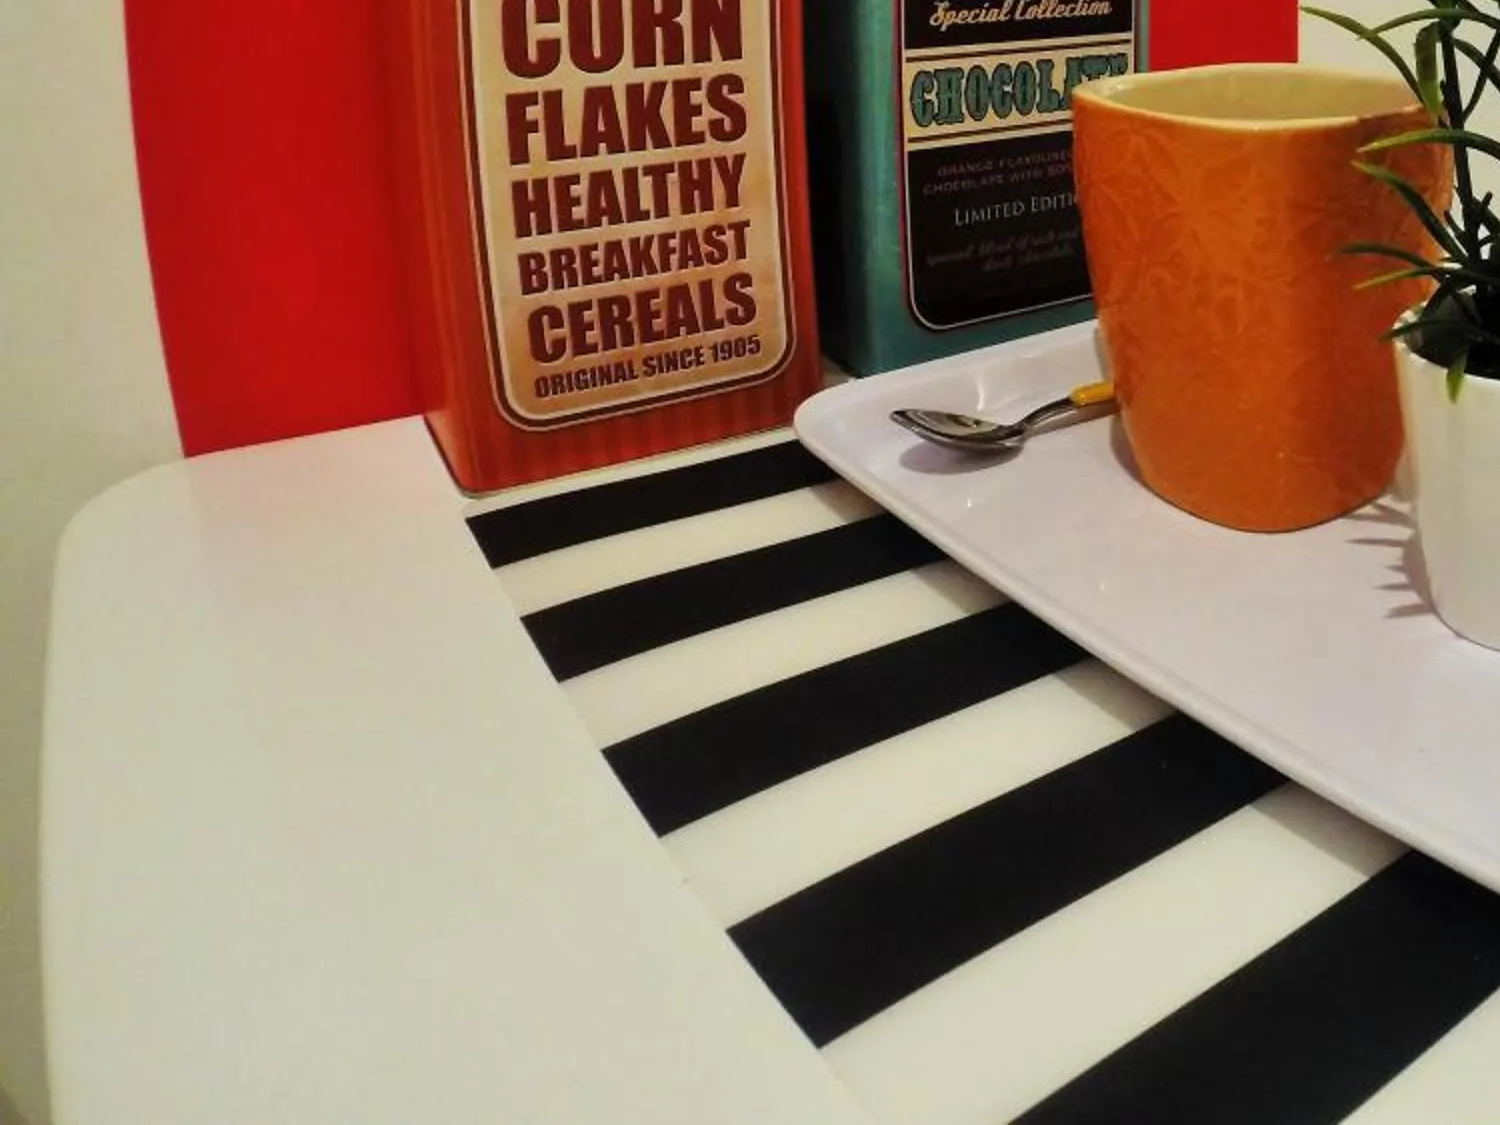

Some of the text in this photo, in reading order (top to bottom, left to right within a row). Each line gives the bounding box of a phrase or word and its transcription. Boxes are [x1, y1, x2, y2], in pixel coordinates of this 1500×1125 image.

[505, 73, 747, 166] FLAKES
[510, 152, 747, 239] HEALTHY
[954, 201, 1025, 226] LIMITED
[517, 220, 751, 296] BREAKFAST
[527, 272, 757, 364] CEREALS
[534, 334, 761, 399] ORIGINAL SINCE 1905
